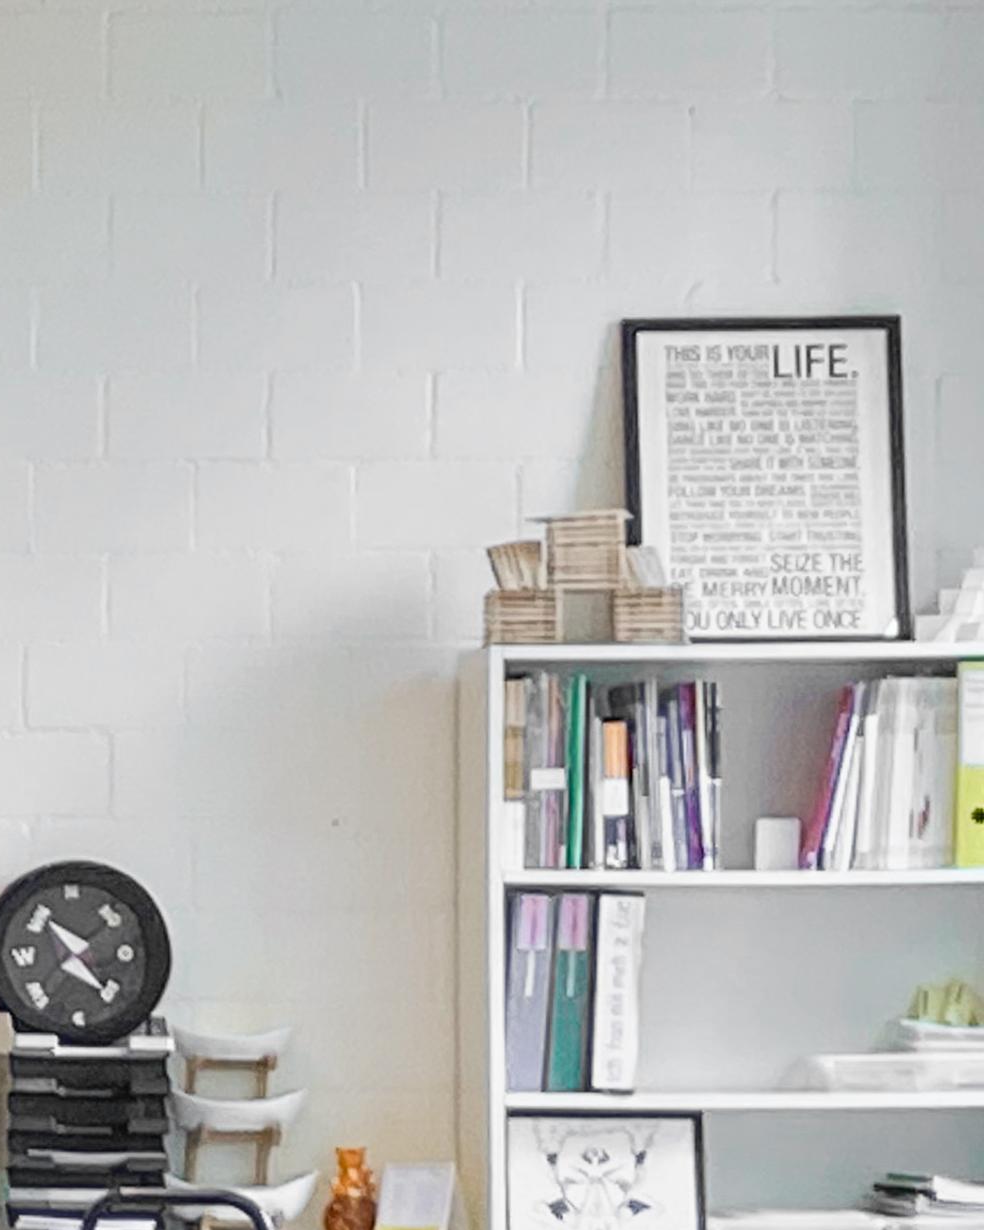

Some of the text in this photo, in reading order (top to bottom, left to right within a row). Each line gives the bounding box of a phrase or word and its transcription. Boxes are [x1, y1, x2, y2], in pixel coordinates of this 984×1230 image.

[664, 344, 701, 361] THIS
[706, 344, 722, 361] IS
[727, 344, 769, 361] YOUR
[773, 343, 859, 378] LIFE.
[770, 553, 864, 573] SEIZE THE
[702, 581, 767, 598] MERRY
[685, 611, 711, 630] OU
[717, 611, 762, 630] ONLY
[768, 611, 807, 629] LIVE
[11, 946, 36, 967] W
